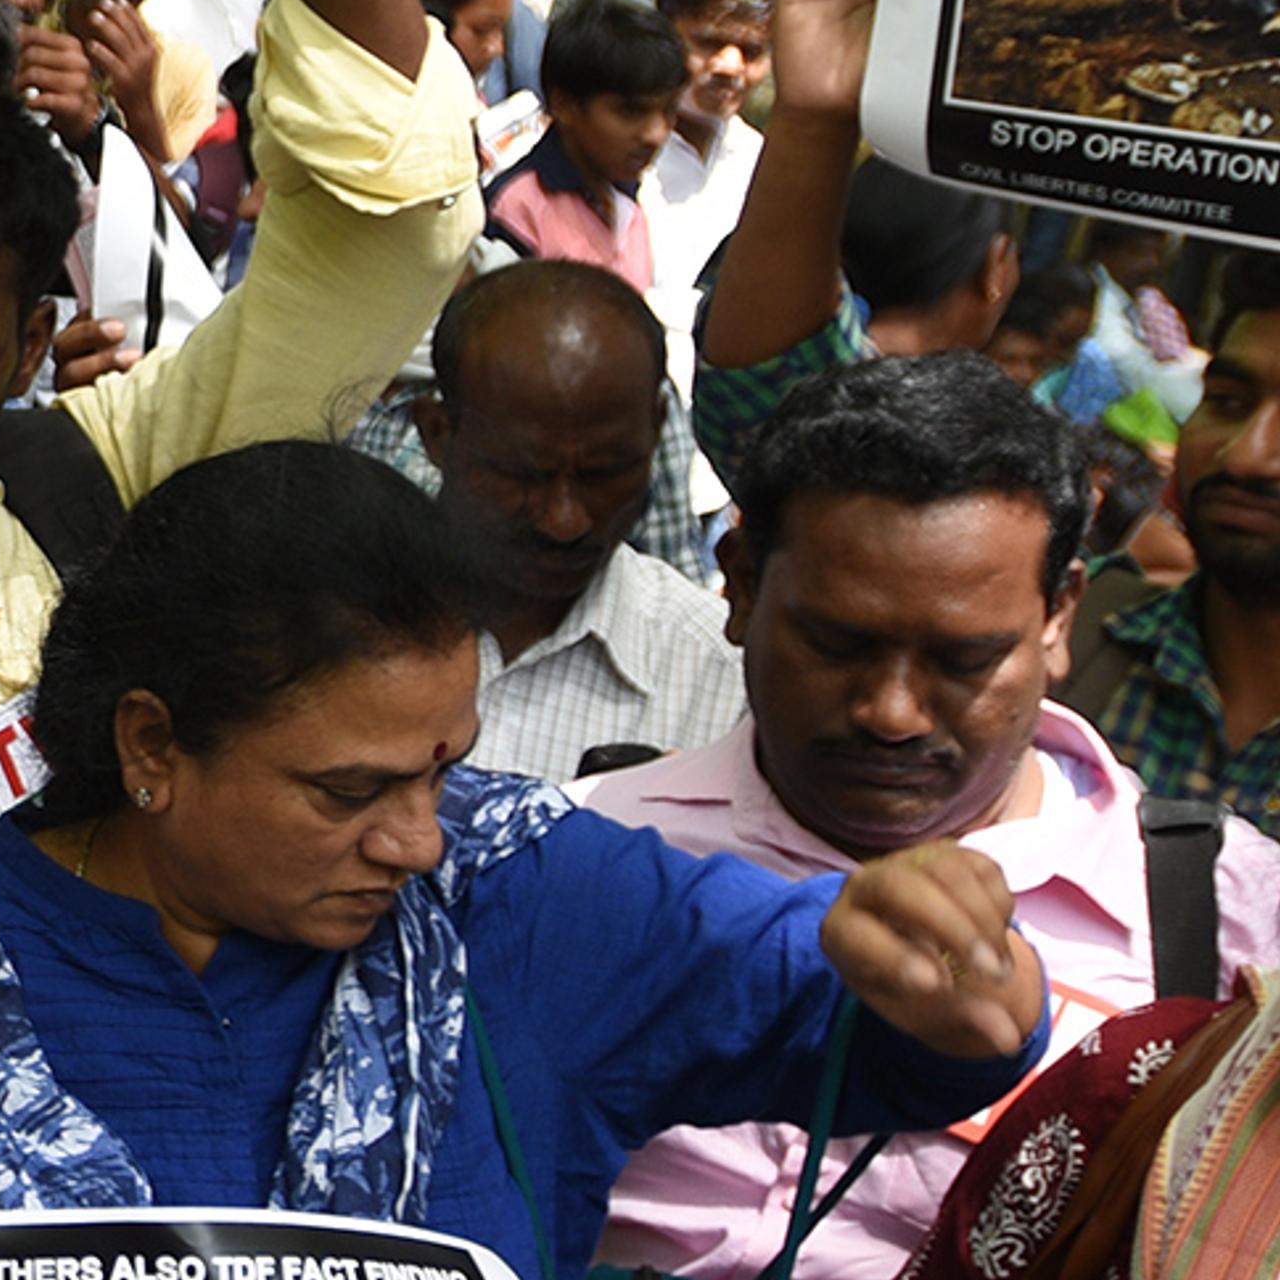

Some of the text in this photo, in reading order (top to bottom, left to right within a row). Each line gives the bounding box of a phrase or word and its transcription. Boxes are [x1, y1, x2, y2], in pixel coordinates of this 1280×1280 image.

[990, 119, 1279, 185] STOP OPERATION
[960, 161, 1234, 222] CIVIL LIBERTIES COMMITTEE
